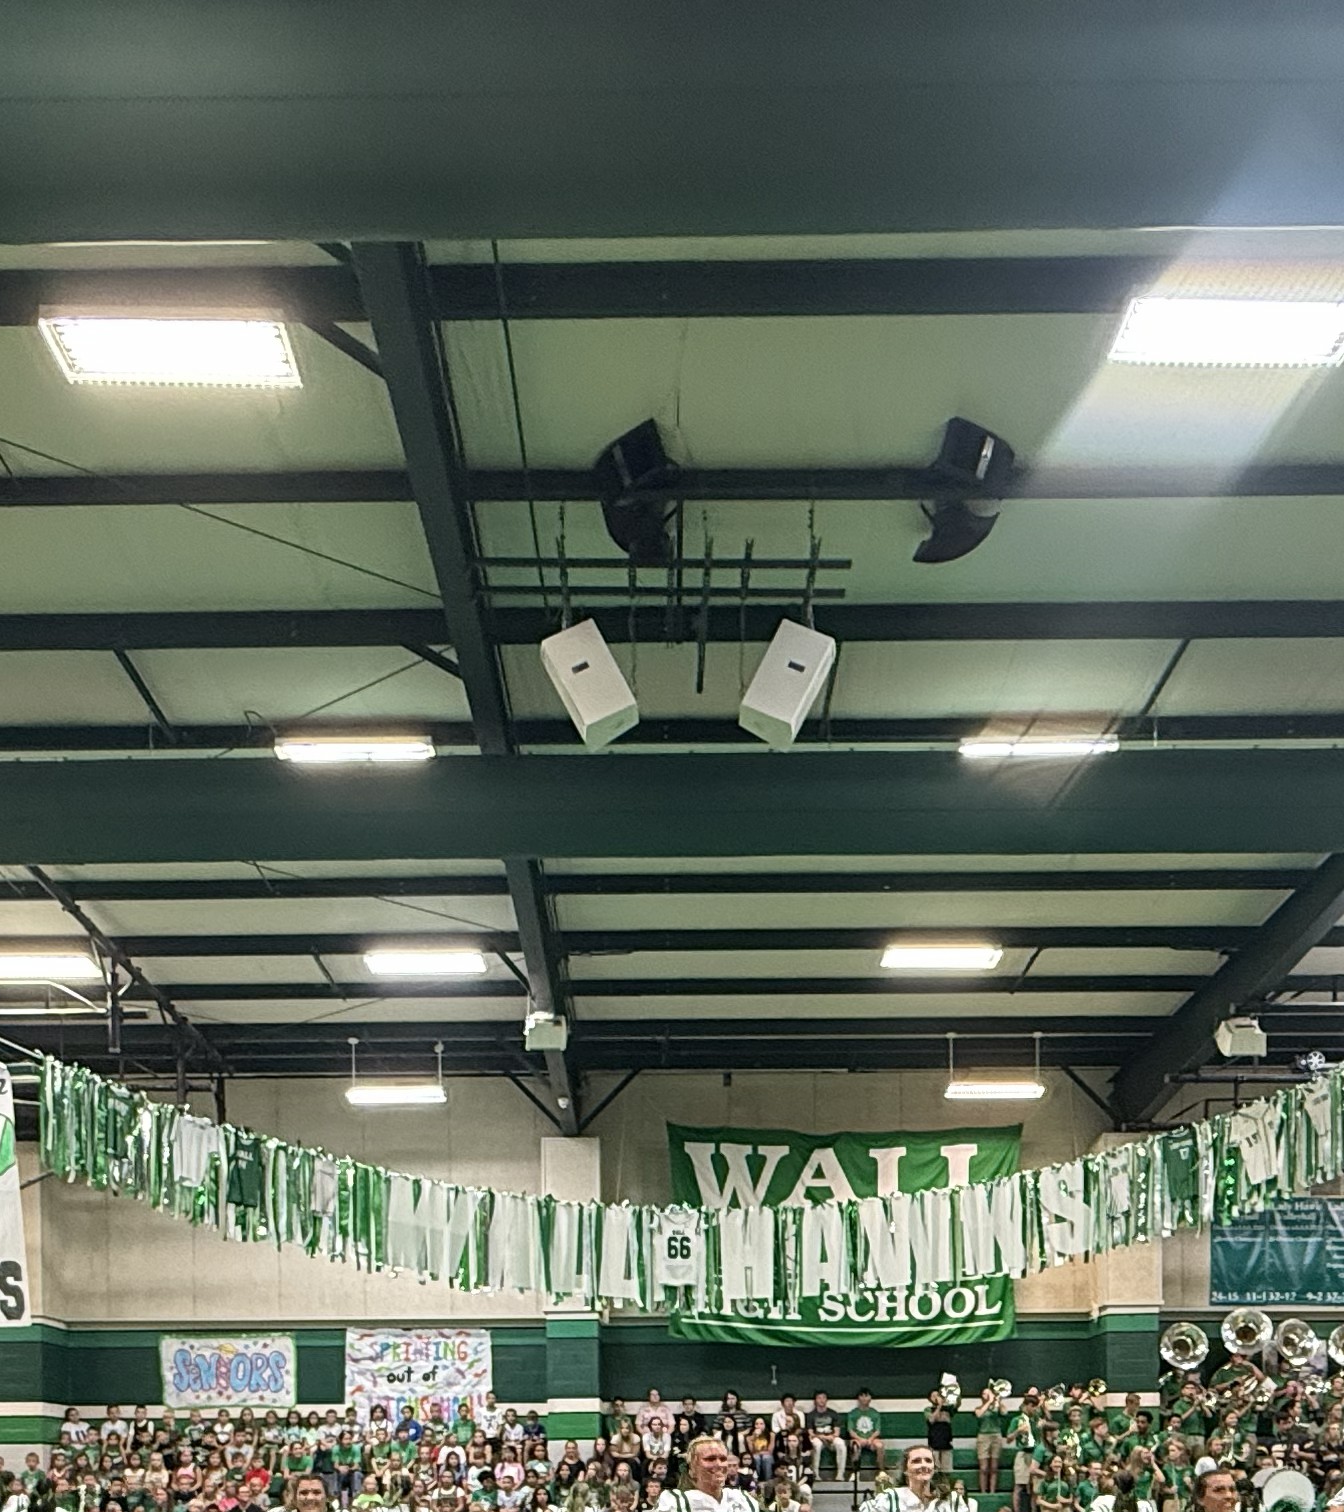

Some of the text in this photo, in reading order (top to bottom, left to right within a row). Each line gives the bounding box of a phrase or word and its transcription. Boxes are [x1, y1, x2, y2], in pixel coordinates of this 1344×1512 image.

[667, 1236, 692, 1260] 66
[818, 1284, 1003, 1322] SCHOOL
[387, 1365, 439, 1384] out of
